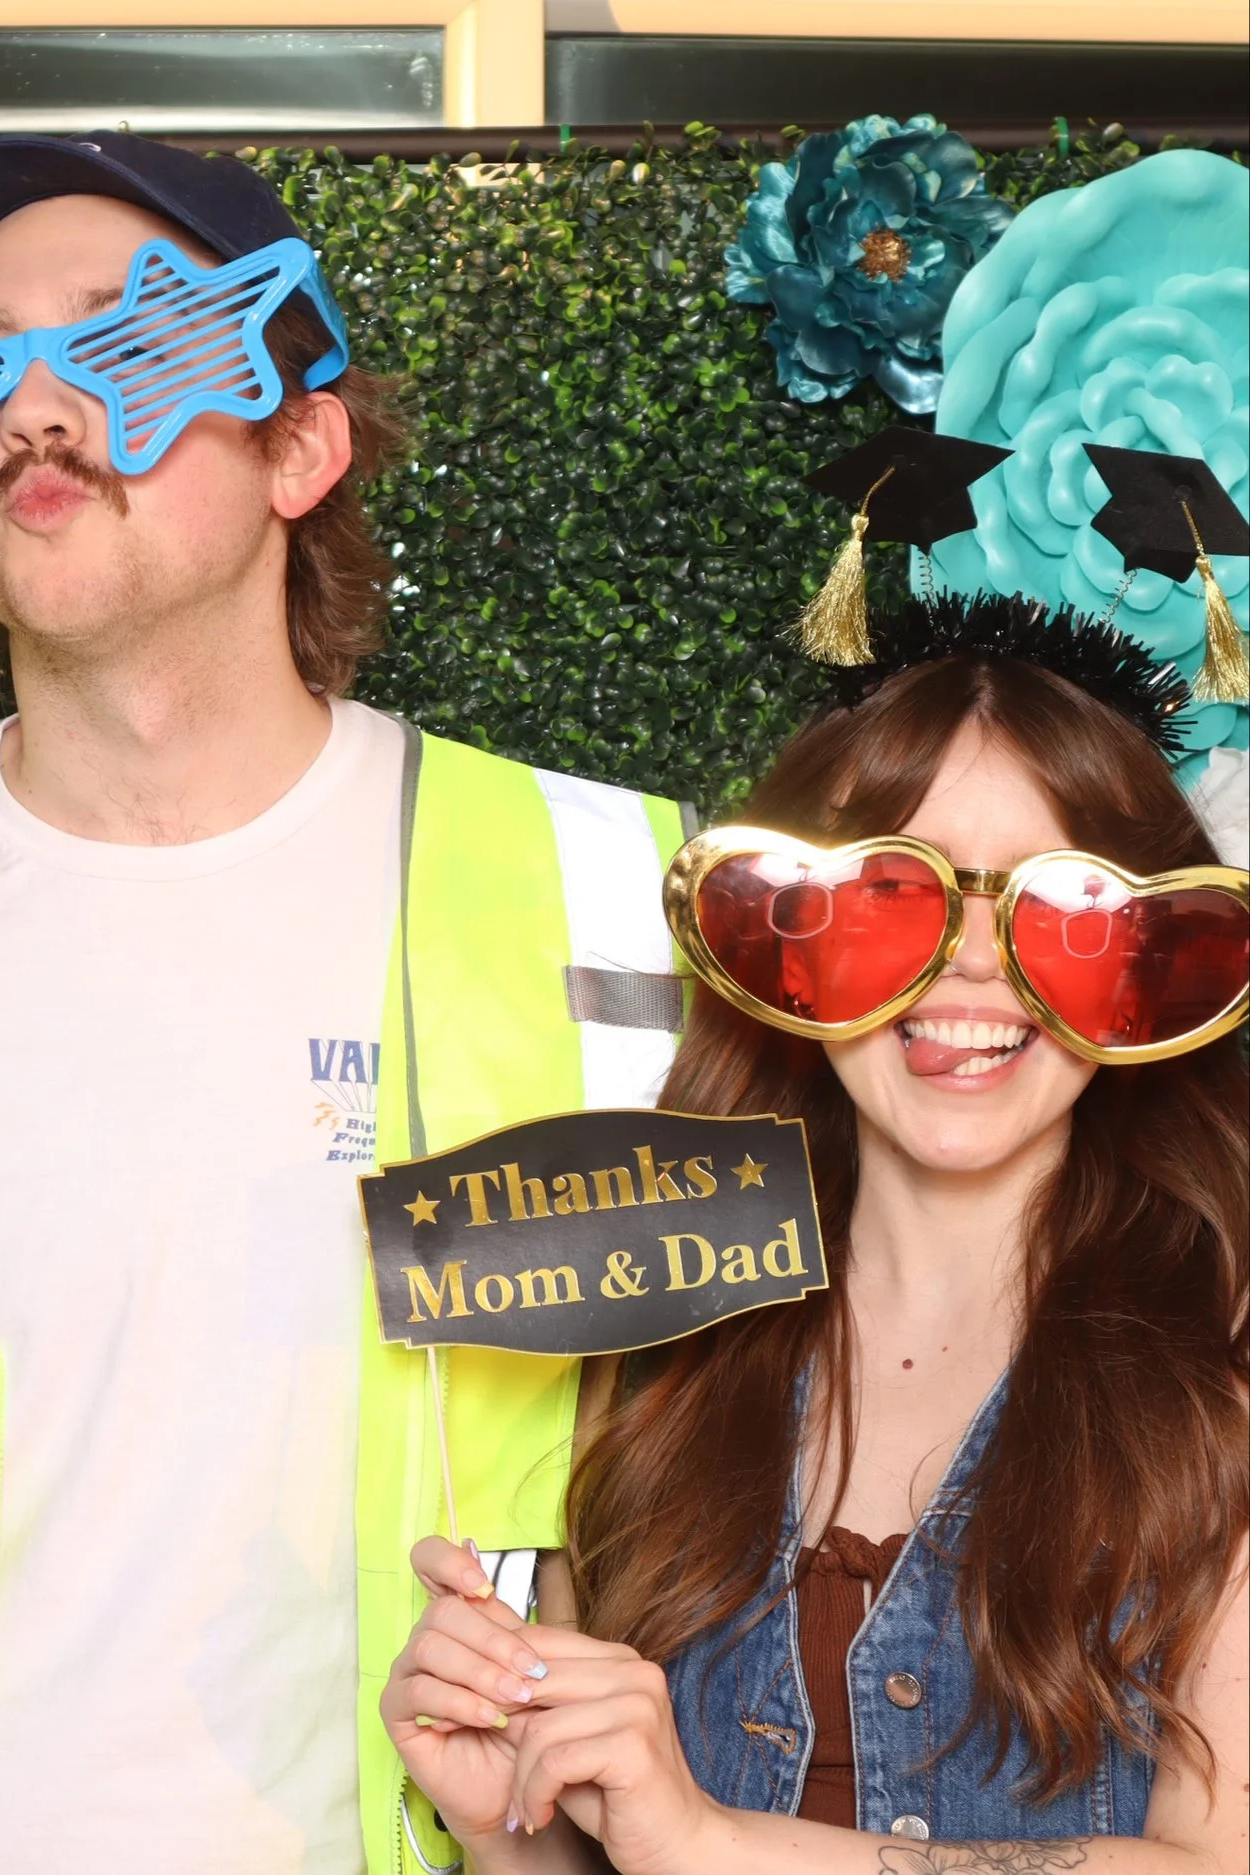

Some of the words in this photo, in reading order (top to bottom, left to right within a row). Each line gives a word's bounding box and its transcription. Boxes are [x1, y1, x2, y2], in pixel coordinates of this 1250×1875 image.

[326, 1150, 375, 1163] Explor
[449, 1145, 718, 1228] Thanks
[400, 1259, 585, 1324] Mom
[600, 1250, 650, 1300] &
[658, 1218, 809, 1292] Dad
